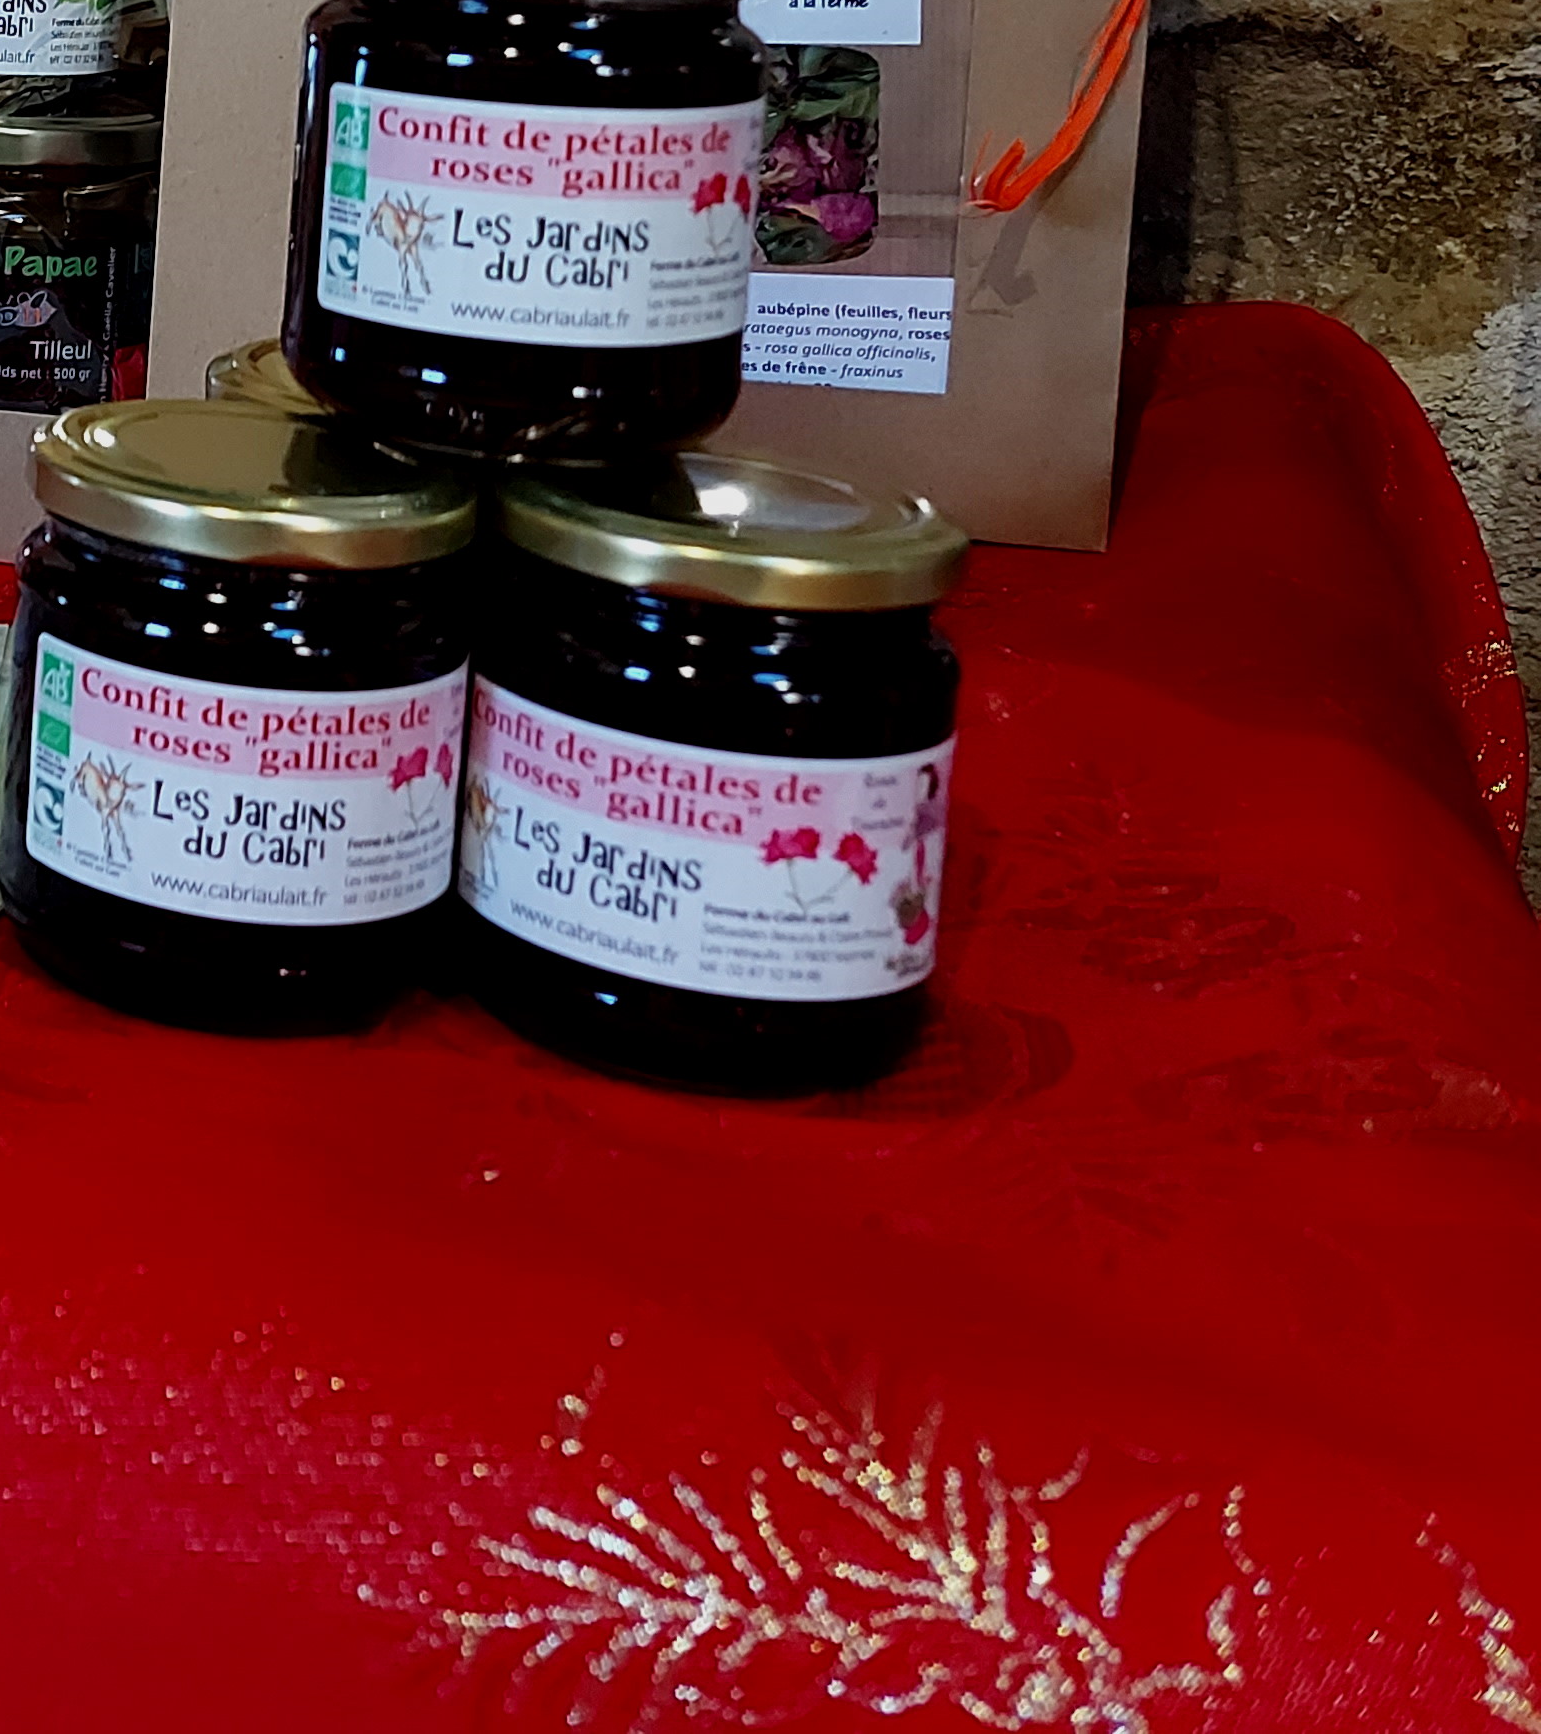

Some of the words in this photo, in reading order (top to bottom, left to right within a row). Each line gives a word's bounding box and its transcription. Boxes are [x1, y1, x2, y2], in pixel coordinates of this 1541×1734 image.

[378, 106, 490, 148] Confit
[503, 121, 552, 151] de
[563, 123, 693, 162] pétales
[700, 123, 732, 155] de
[430, 157, 534, 187] roses
[757, 303, 830, 318] aubépine
[835, 305, 903, 321] (feuilles,
[816, 326, 903, 342] monogyna,
[907, 329, 950, 342] roses
[30, 339, 92, 360] Tilleul
[764, 343, 798, 355] rosa
[802, 344, 853, 360] gallica
[856, 344, 937, 363] officinalis,
[20, 367, 42, 379] net
[53, 367, 76, 380] 500
[762, 360, 781, 373] de
[785, 360, 827, 376] frêne
[839, 364, 904, 379] fraxinus
[80, 667, 187, 722] Confit
[201, 697, 248, 732] de
[260, 706, 391, 745] pétales
[399, 699, 430, 729] de
[131, 724, 232, 764] roses
[502, 750, 582, 801] roses
[554, 732, 598, 769] de
[608, 754, 761, 802] pétales
[773, 772, 824, 805] de
